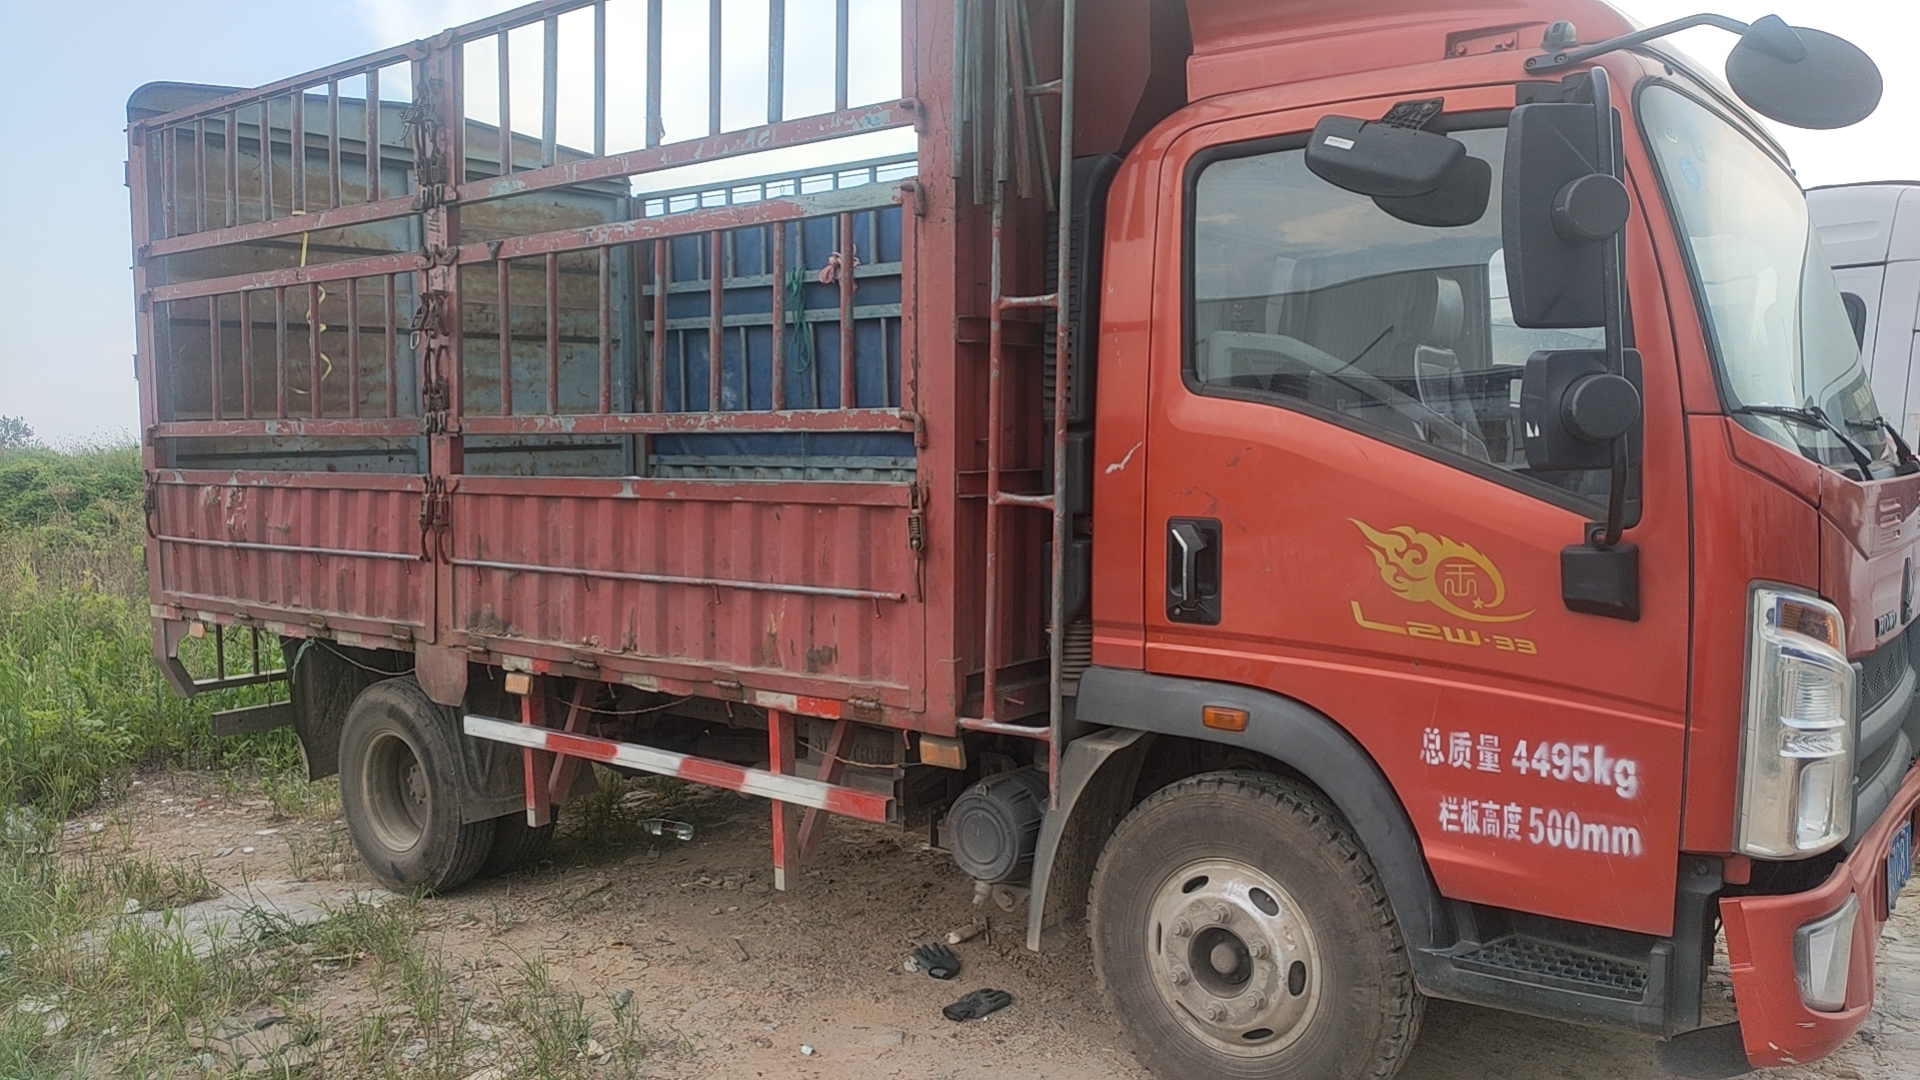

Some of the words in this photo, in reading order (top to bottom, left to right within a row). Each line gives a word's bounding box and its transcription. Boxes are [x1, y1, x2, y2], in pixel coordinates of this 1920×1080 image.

[1878, 610, 1898, 637] HOW
[1419, 726, 1502, 774] 总质量
[1511, 738, 1640, 799] 4495kg
[1438, 796, 1523, 841] 栏板高度
[1528, 805, 1642, 857] 500mm
